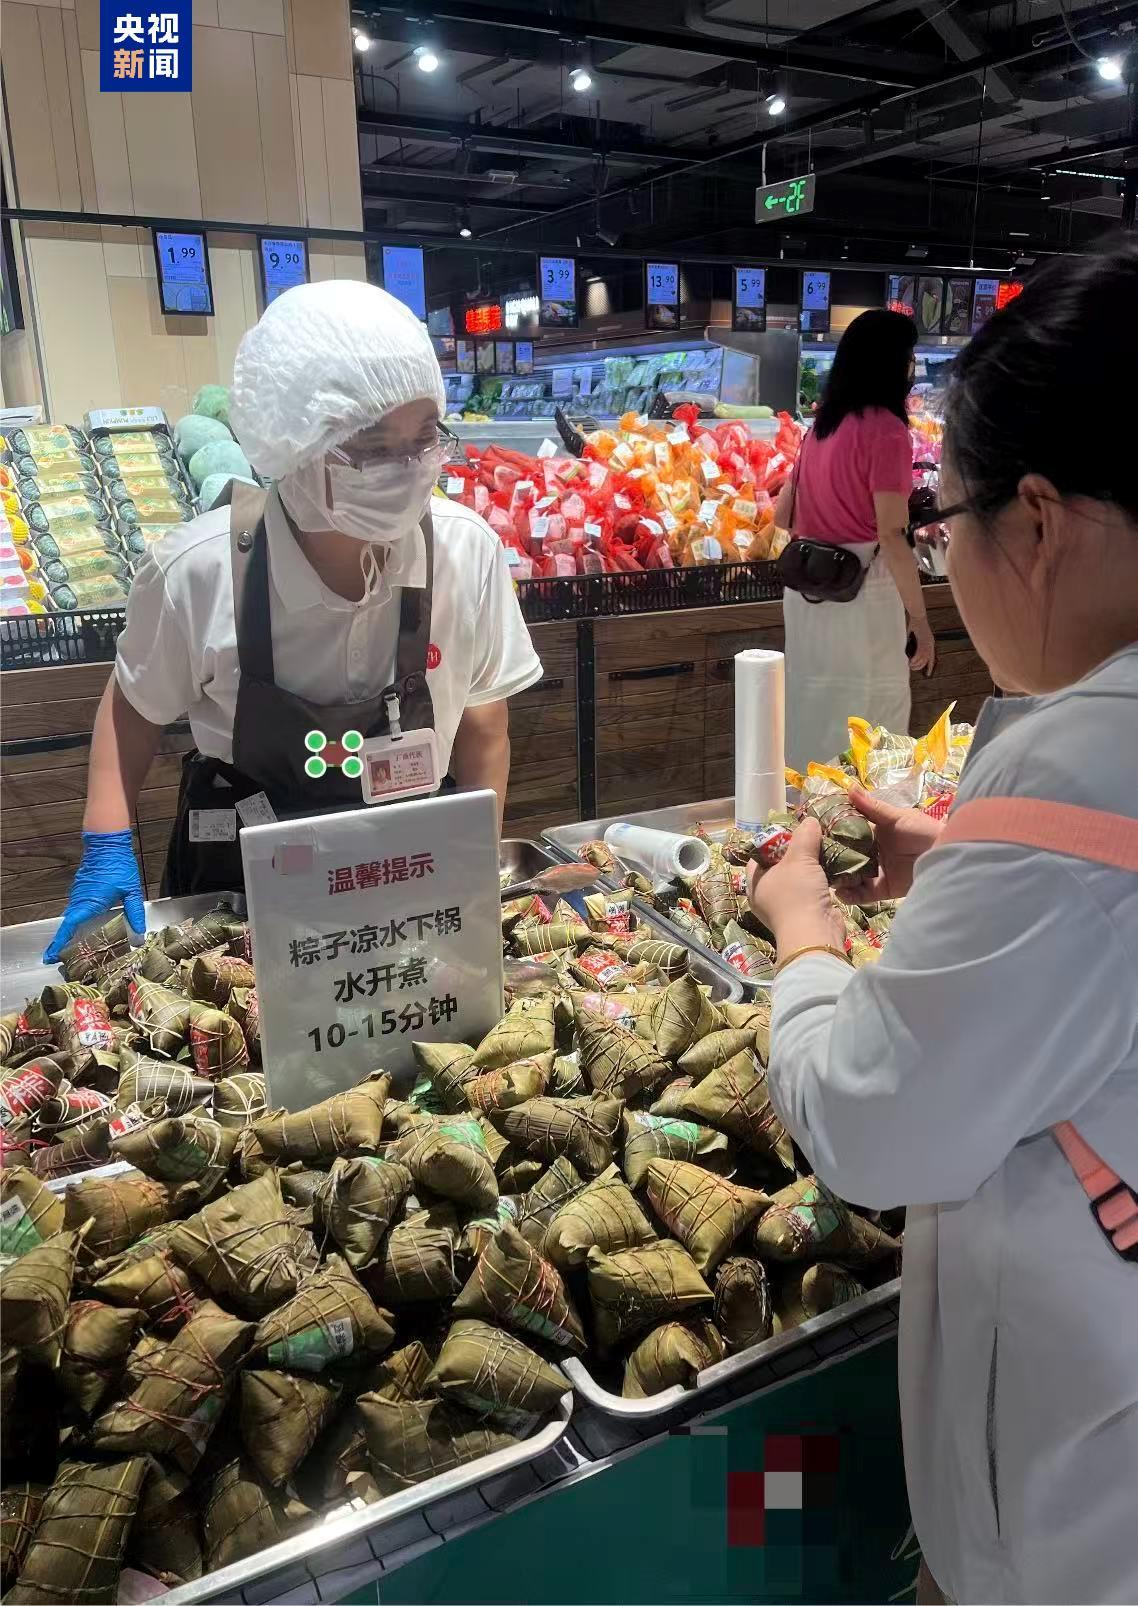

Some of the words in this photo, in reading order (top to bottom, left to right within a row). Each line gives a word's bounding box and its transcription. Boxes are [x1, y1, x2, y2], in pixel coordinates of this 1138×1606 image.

[168, 247, 196, 264] 1.99
[269, 252, 300, 270] 9.90
[547, 269, 570, 284] 3.99
[650, 275, 675, 288] 13.90
[327, 852, 435, 895] 温馨提示
[288, 906, 462, 967] 粽子凉水下锅
[333, 956, 428, 1003] 水开煮
[307, 993, 458, 1052] 10-15分钟
